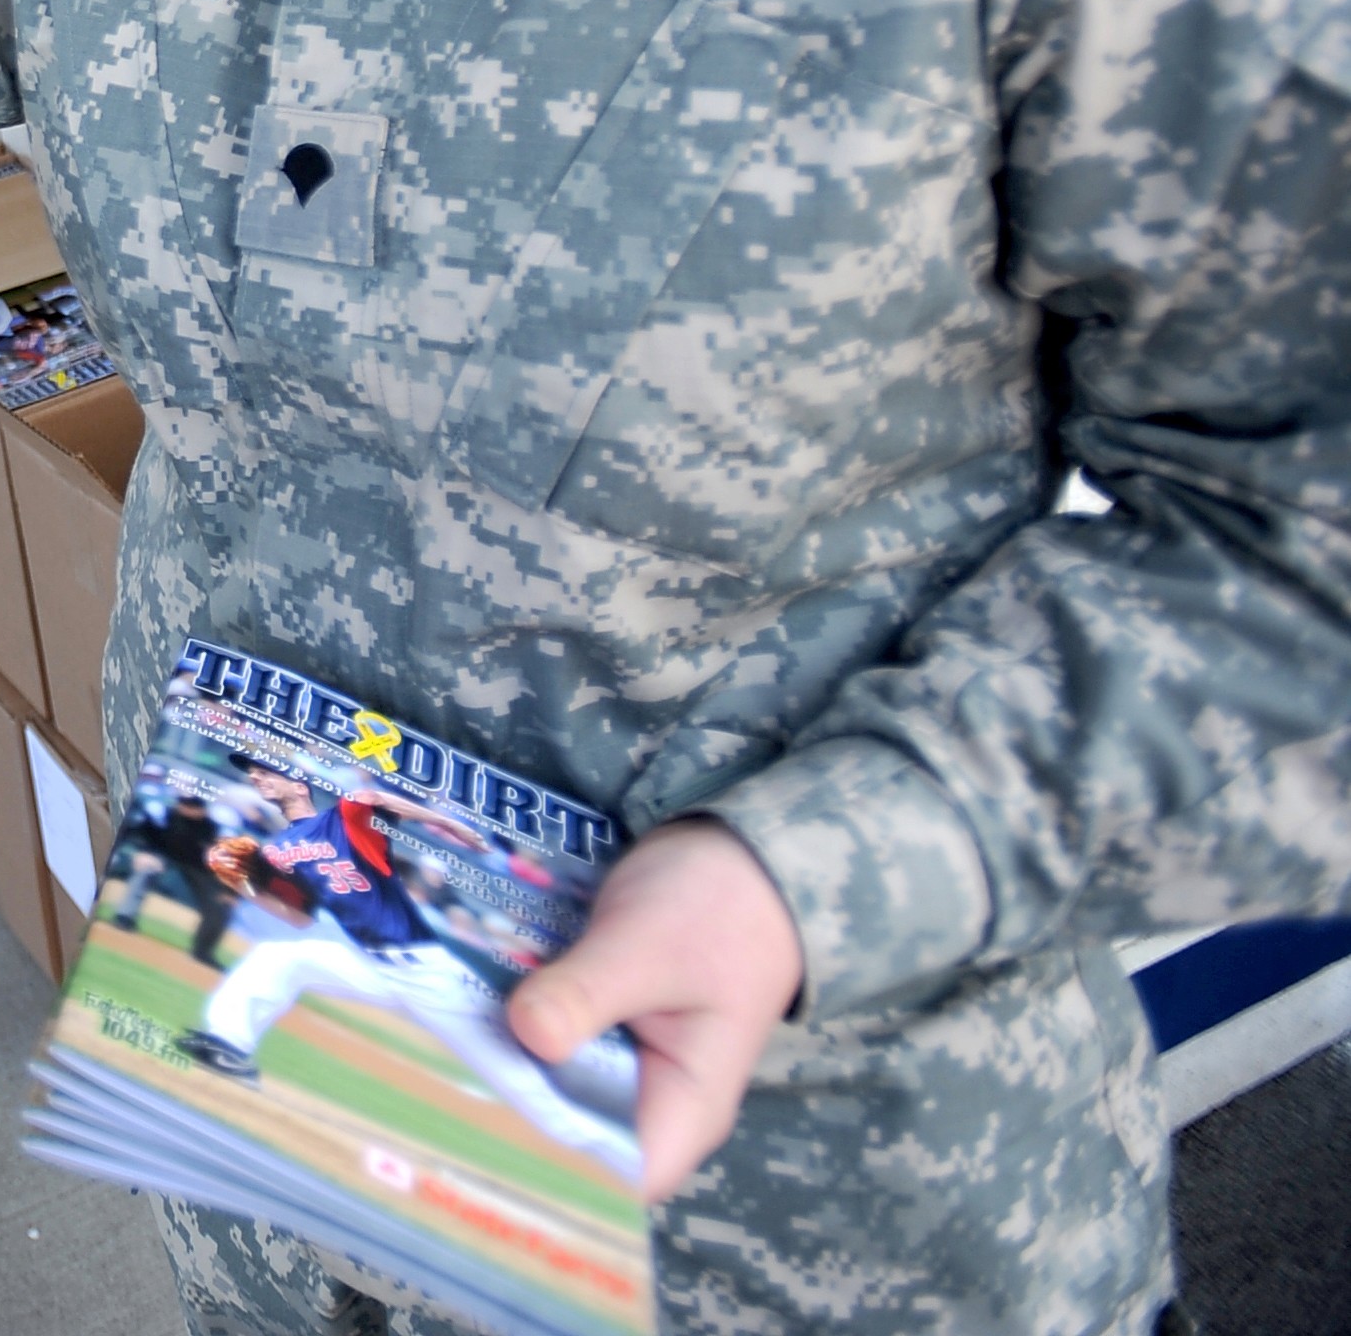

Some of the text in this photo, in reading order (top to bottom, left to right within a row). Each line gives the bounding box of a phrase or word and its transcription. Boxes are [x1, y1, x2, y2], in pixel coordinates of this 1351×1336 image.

[169, 715, 251, 758] Saturday,
[254, 748, 291, 775] May
[310, 775, 356, 802] 2010
[174, 705, 288, 759] Las Vegas 51s
[177, 696, 337, 771] Tacoma Rainiers vs.
[183, 638, 612, 864] THE DIRT
[220, 699, 272, 726] Official
[274, 721, 315, 745] Game
[317, 738, 383, 778] Program
[382, 771, 400, 786] of
[401, 780, 428, 800] the
[430, 796, 489, 828] Tacoma
[165, 777, 218, 803] Pitcher
[201, 778, 227, 796] Lee
[317, 861, 372, 894] 35
[370, 816, 537, 905] Rounding the
[442, 872, 498, 906] with
